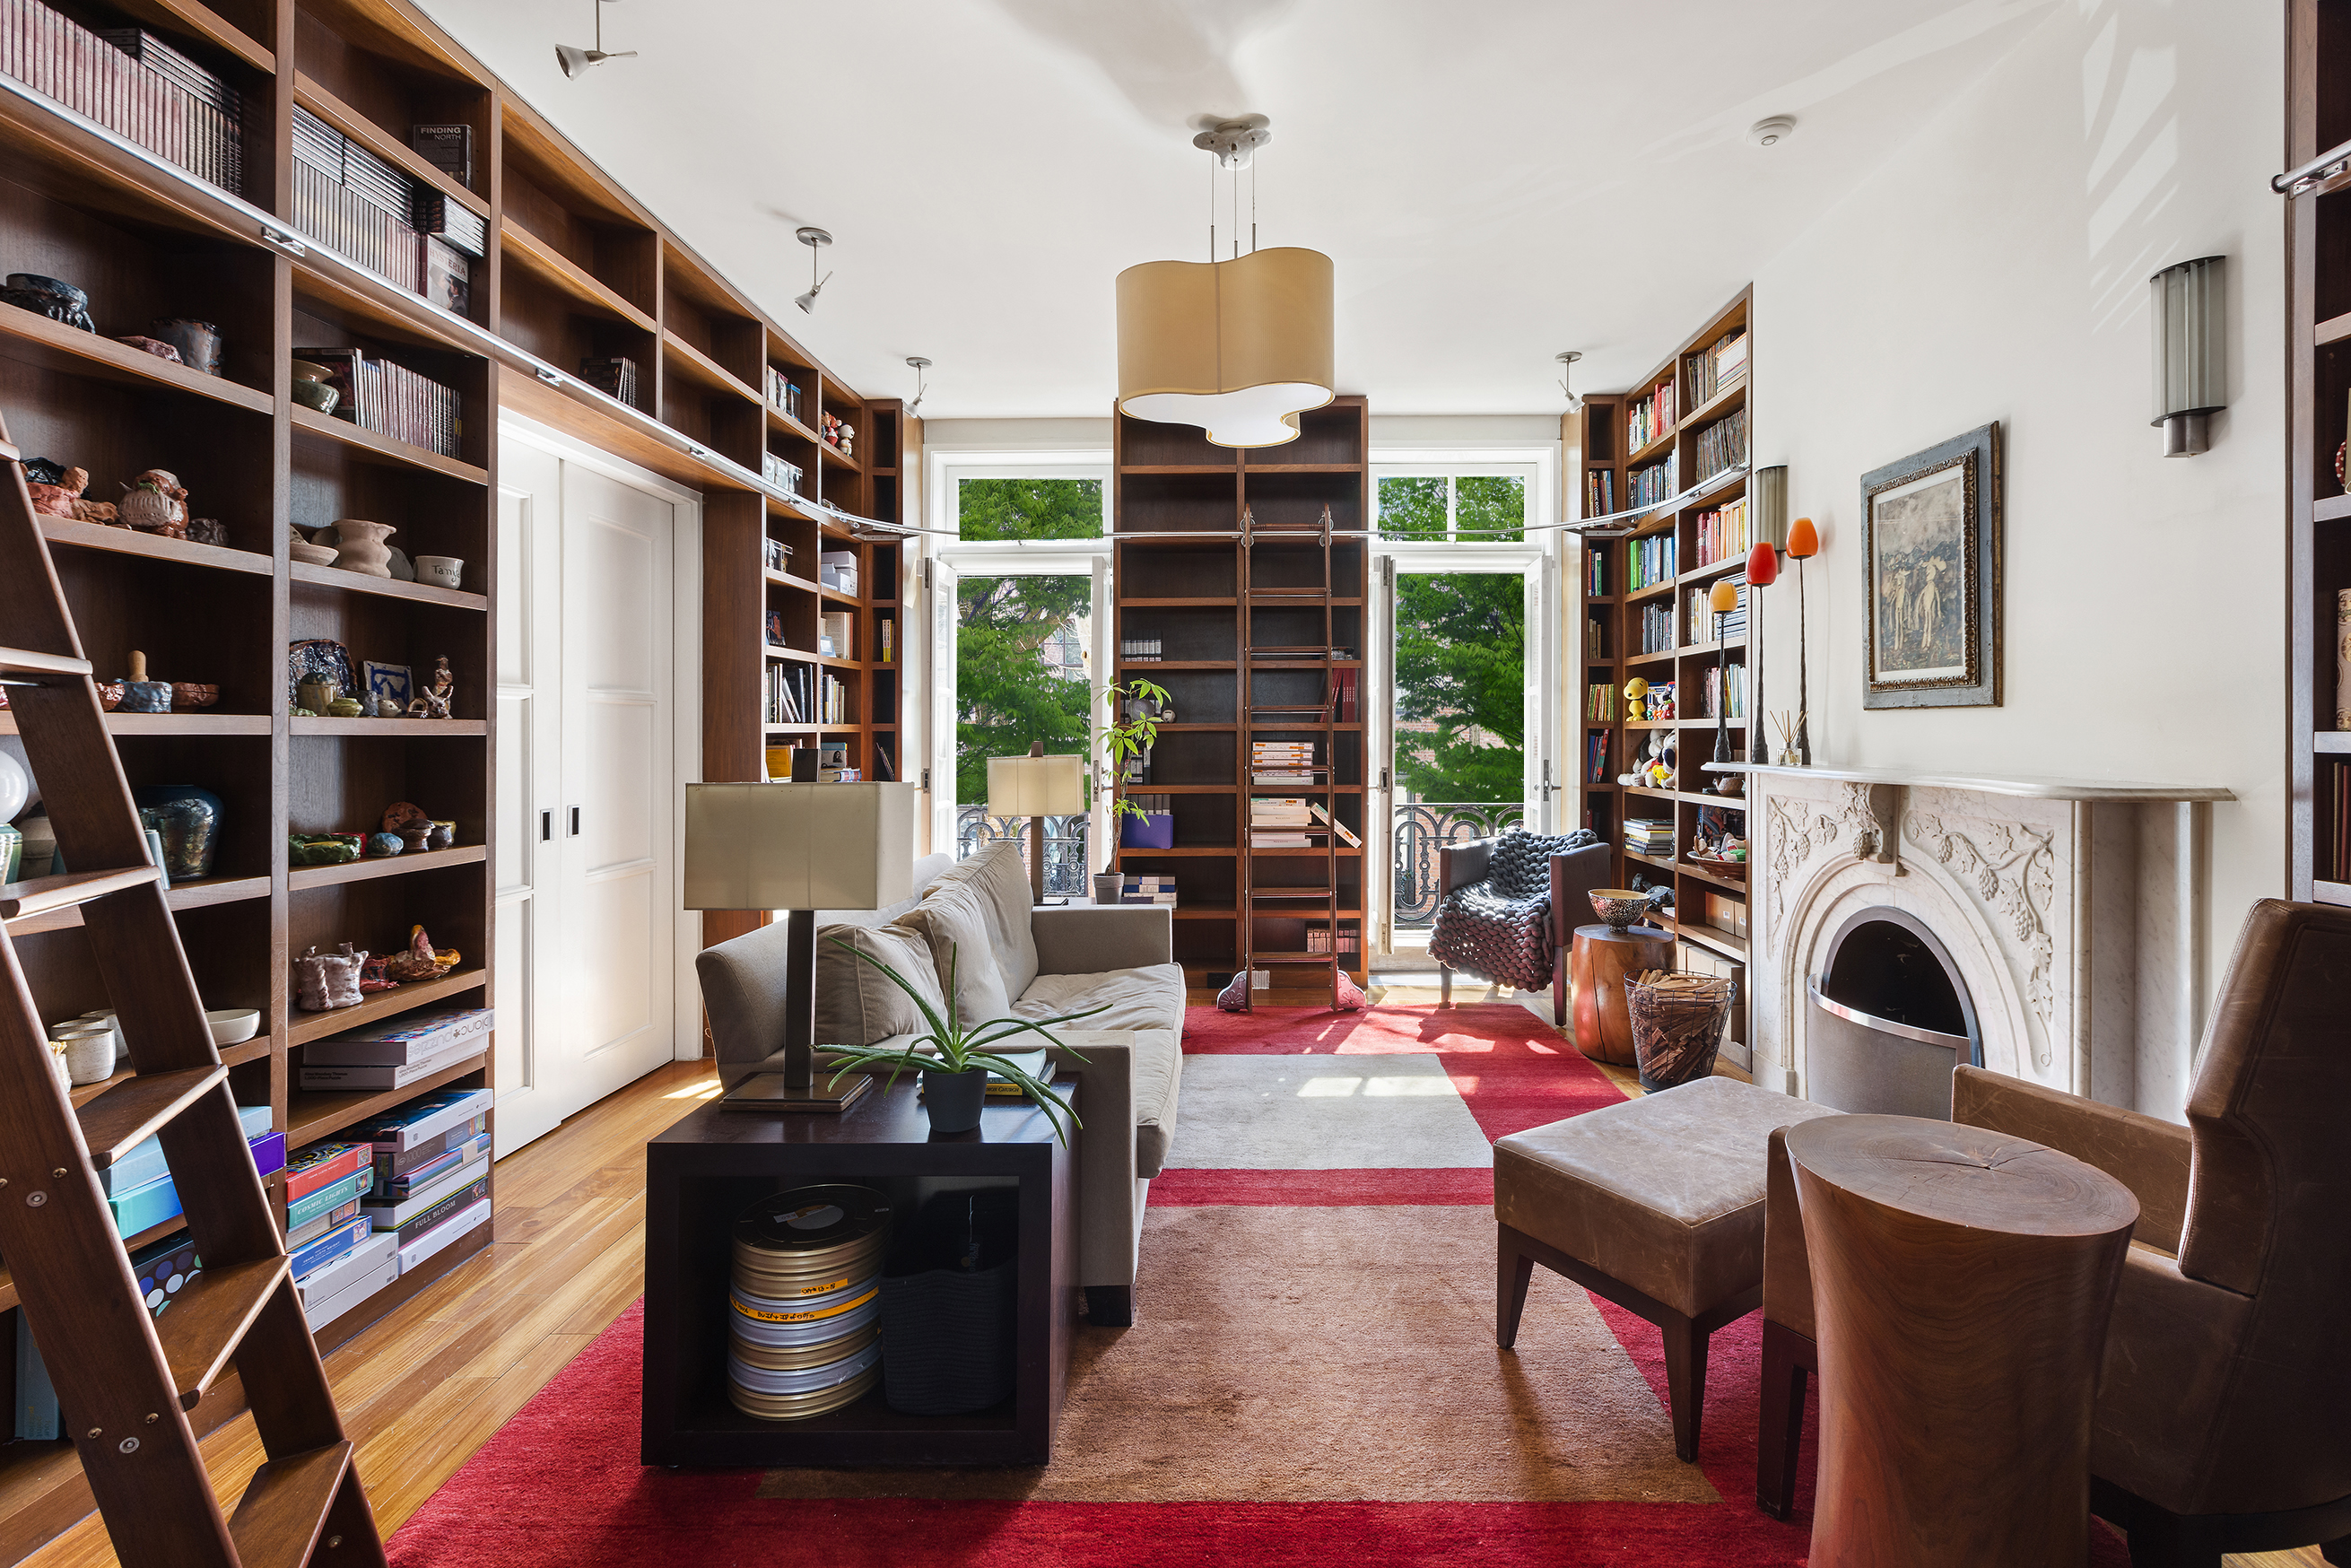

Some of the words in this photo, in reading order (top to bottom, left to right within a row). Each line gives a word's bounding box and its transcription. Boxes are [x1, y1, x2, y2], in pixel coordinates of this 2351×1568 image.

[430, 248, 466, 276] HYSTERIA
[407, 1028, 452, 1058] puzzles
[406, 1148, 422, 1163] 1000
[297, 1198, 323, 1215] COSMIC
[325, 1187, 348, 1202] LIGHTS
[414, 1215, 431, 1229] FULL
[432, 1200, 456, 1217] BLOOM
